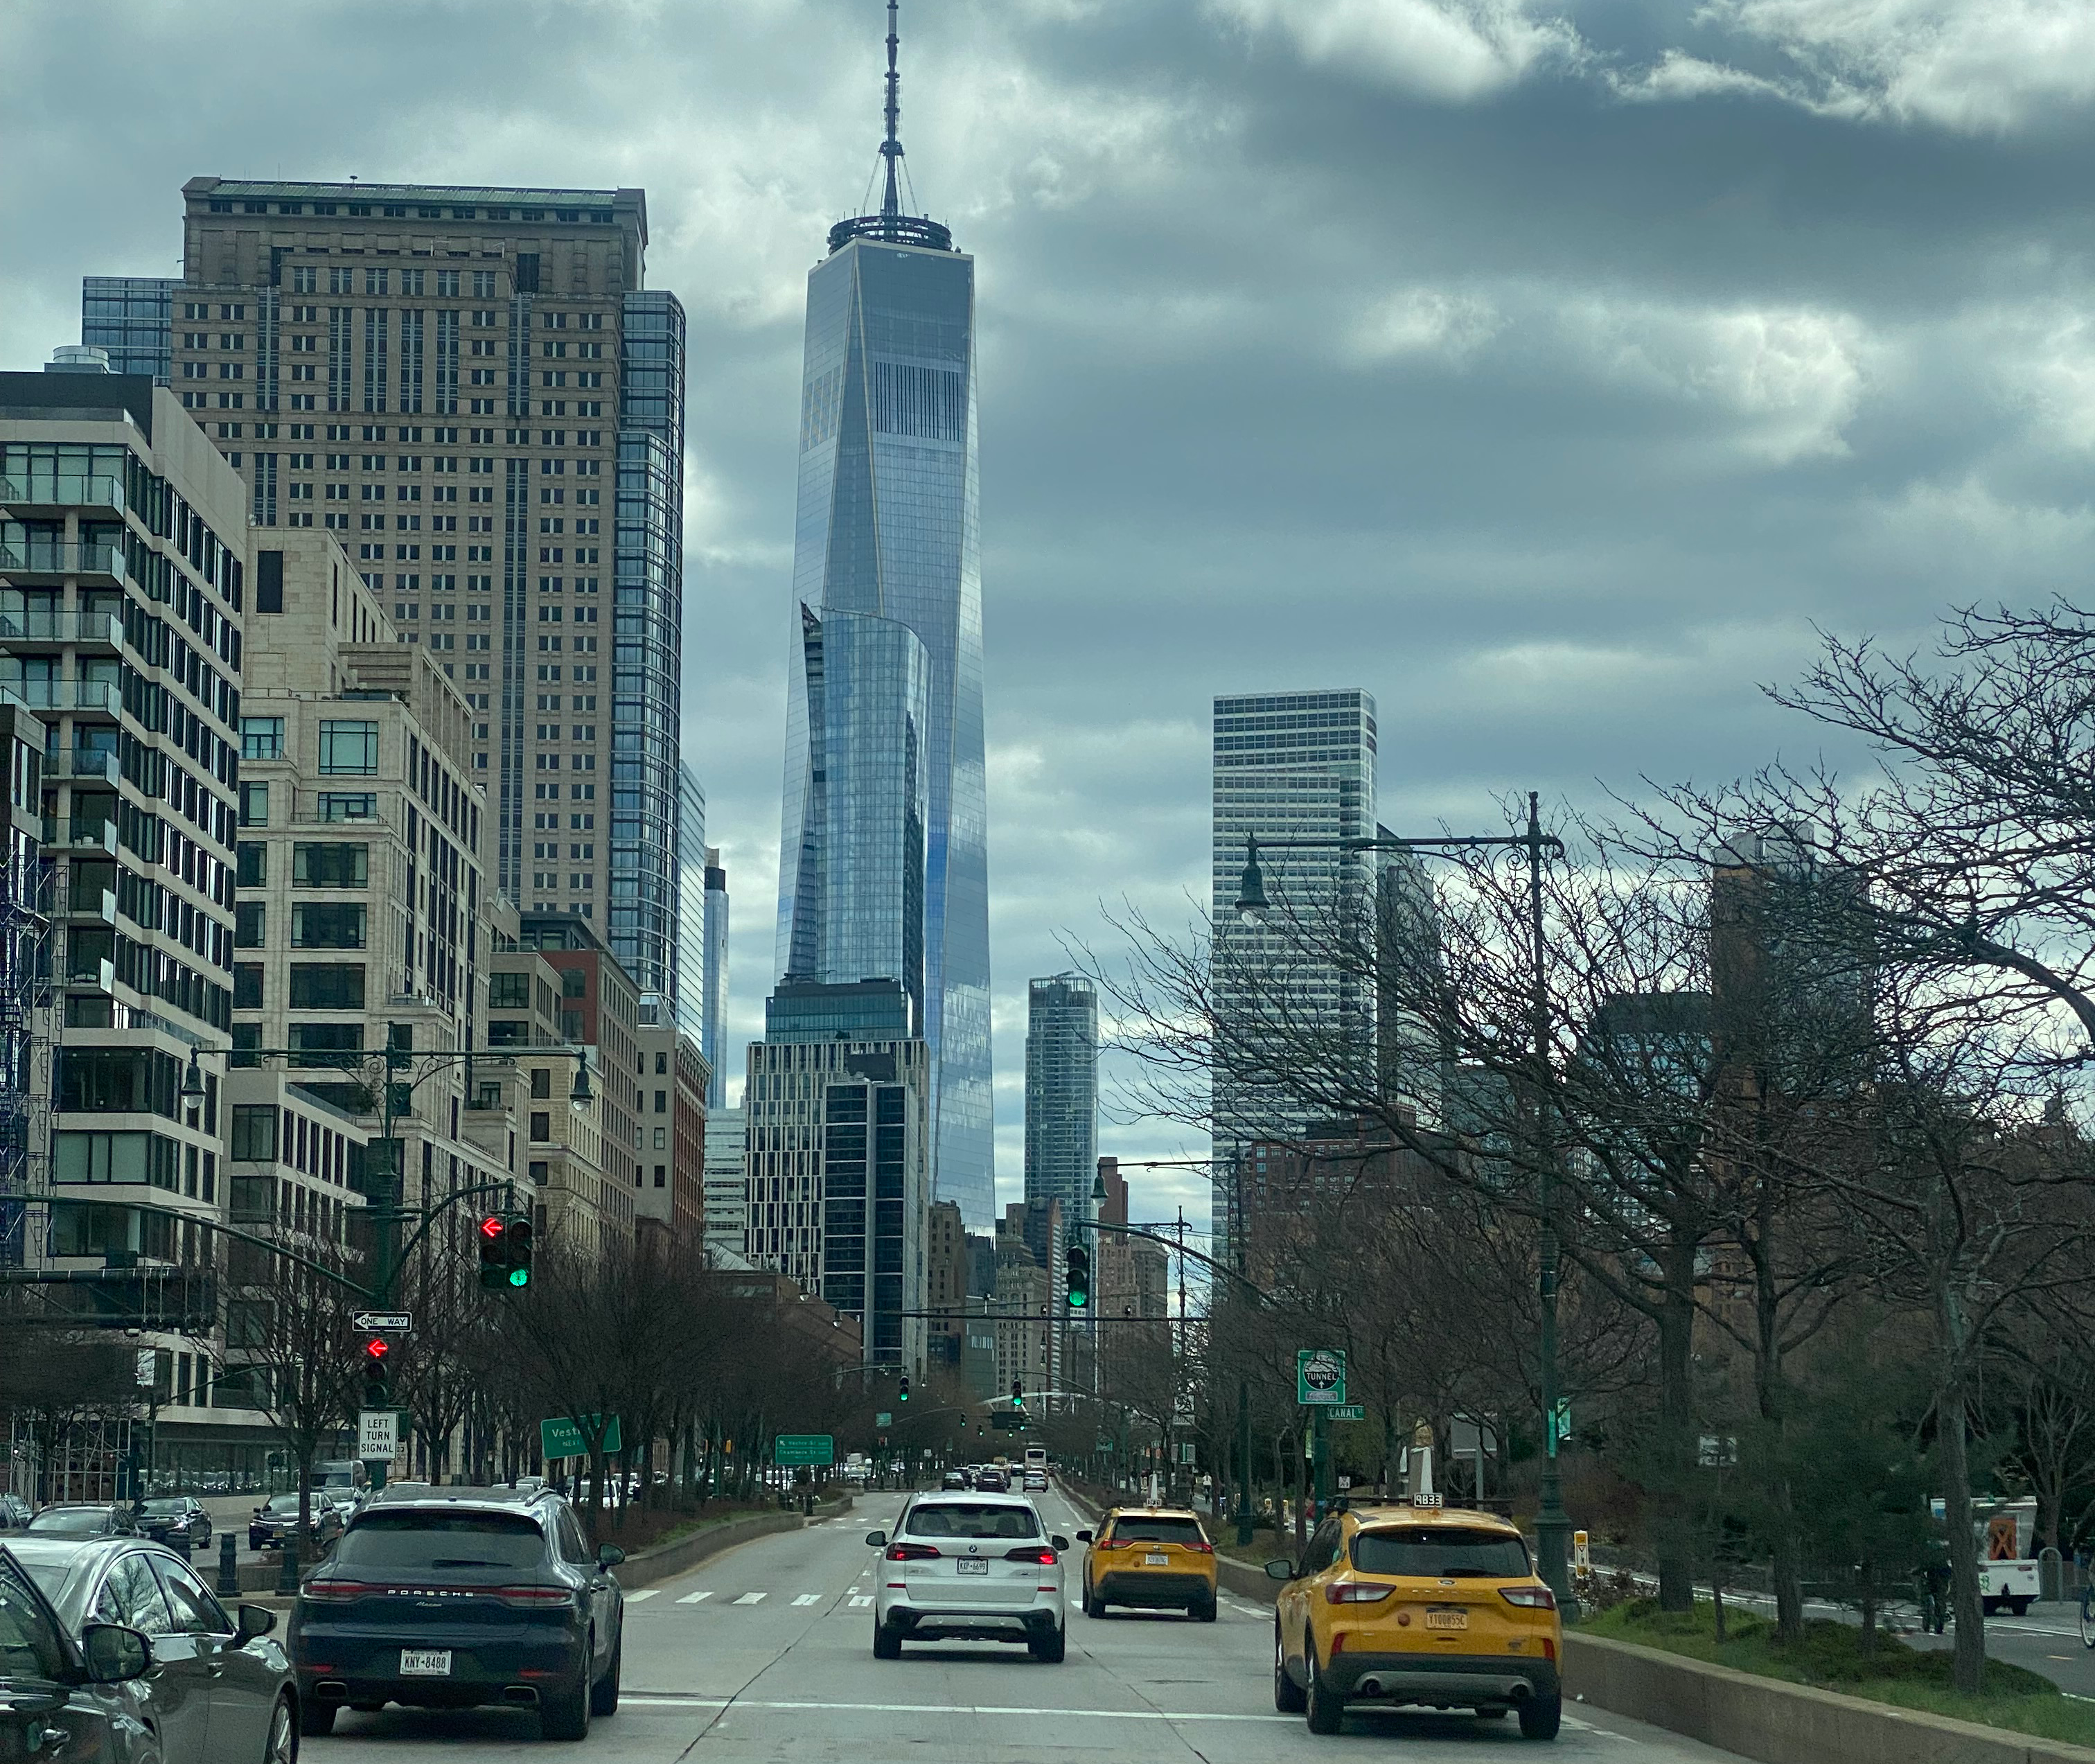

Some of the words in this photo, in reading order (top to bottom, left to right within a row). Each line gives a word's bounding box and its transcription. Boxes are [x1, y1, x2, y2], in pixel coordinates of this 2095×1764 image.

[1307, 1373, 1337, 1381] TUNNEL
[1329, 1407, 1356, 1418] CANAL
[368, 1419, 389, 1428] LEFT
[366, 1431, 389, 1440] TURN
[361, 1443, 394, 1453] SIGNAL
[387, 1589, 474, 1598] PORSCHE
